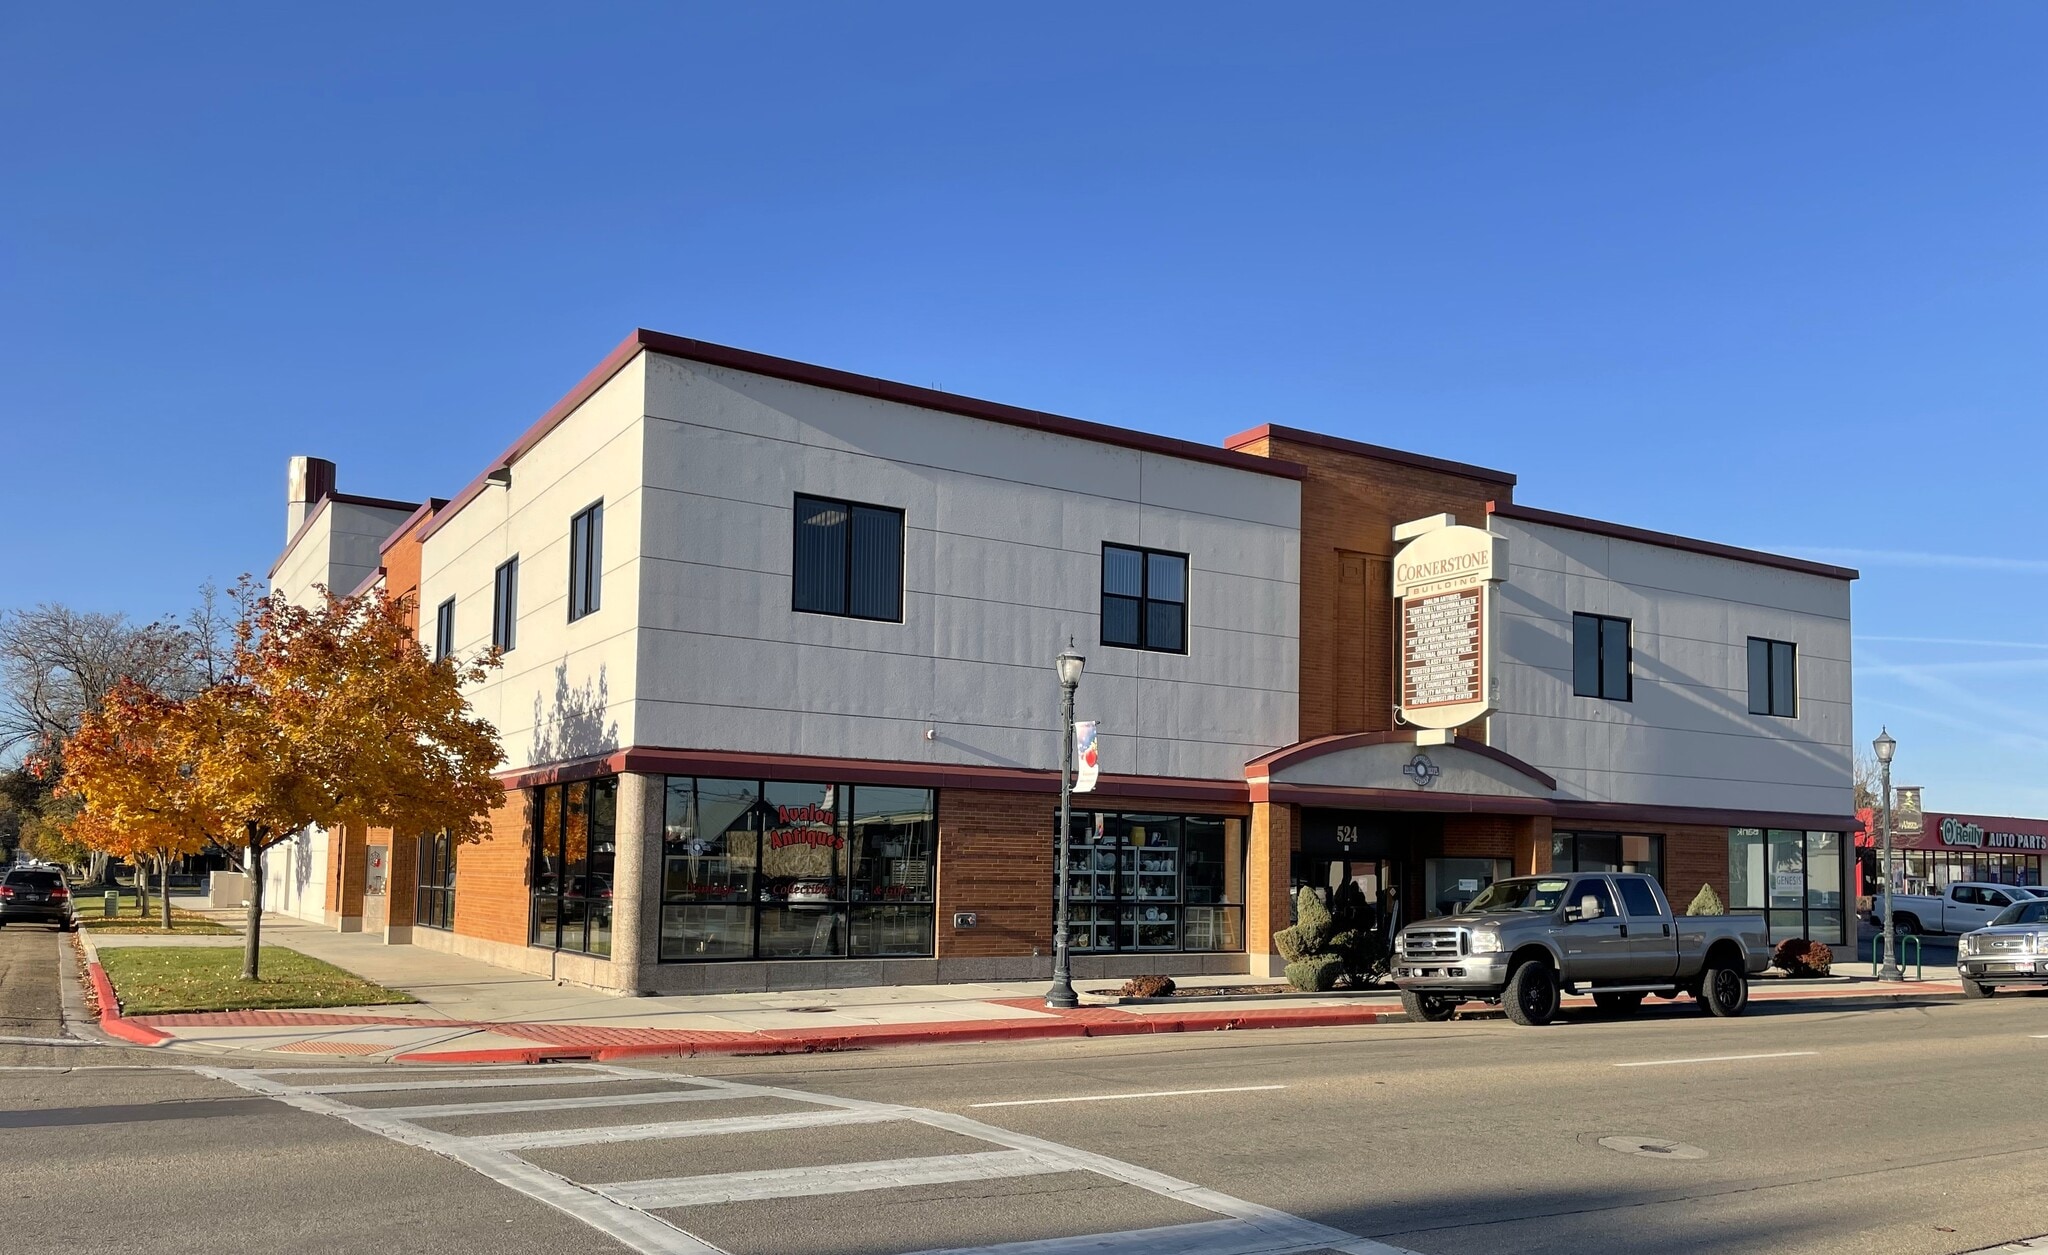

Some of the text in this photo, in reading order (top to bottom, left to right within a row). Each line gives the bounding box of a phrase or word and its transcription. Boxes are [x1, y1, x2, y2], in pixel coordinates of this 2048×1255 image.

[1396, 550, 1488, 582] CORNERSTONE
[1413, 576, 1477, 594] BUILDING
[1460, 598, 1476, 606] HEALTH
[1410, 613, 1430, 622] WESTERN
[1430, 611, 1443, 619] IDAHO
[1458, 606, 1474, 614] CENTER
[1414, 621, 1427, 629] STATE
[1433, 618, 1446, 626] IDAHO
[1441, 625, 1449, 633] TAX
[1450, 622, 1467, 631] SERVICE
[1412, 650, 1435, 660] FRATERNAL
[1436, 648, 1451, 656] ORDER
[1457, 645, 1472, 653] POLICE
[1415, 644, 1428, 652] SNAKE
[1429, 642, 1442, 650] RIVER
[1430, 664, 1451, 672] BUSINESS
[1451, 660, 1474, 669] SOLUTIONS
[1412, 669, 1472, 682] GENESIS COMMUNITY HEALTH
[1451, 677, 1468, 685] CENTER
[1435, 686, 1455, 695] NATIONAL
[1428, 694, 1454, 703] COUNSELING
[1455, 692, 1472, 700] CENTER
[778, 803, 835, 826] Avalon
[771, 825, 845, 850] Antiques
[1336, 825, 1358, 843] 524
[1942, 817, 2047, 849] O'Reilly AUTO PARTS
[1776, 875, 1802, 886] GENESIS
[772, 881, 836, 896] Collectibles
